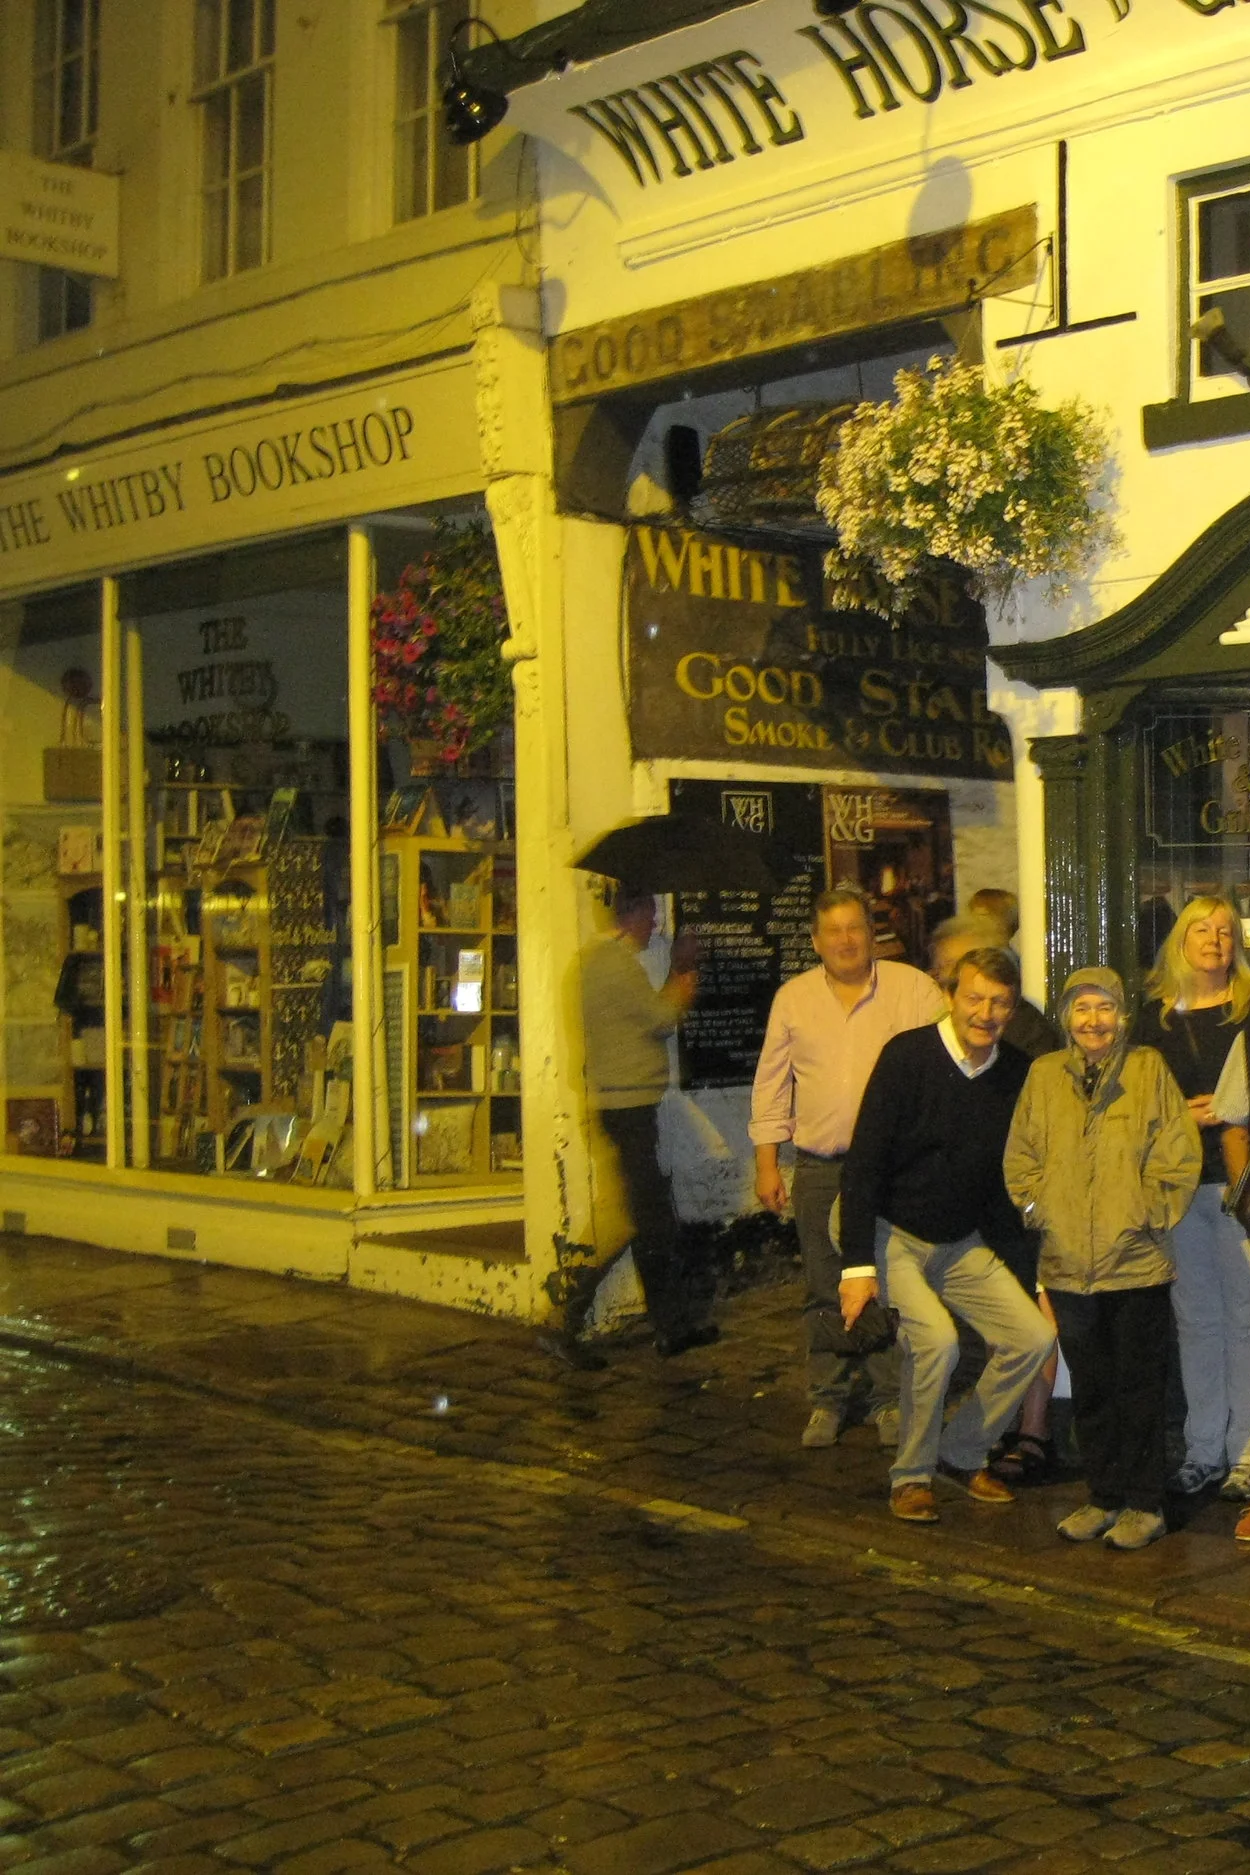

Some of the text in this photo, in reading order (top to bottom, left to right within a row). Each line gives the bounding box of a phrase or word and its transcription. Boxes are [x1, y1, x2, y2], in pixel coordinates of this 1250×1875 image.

[567, 0, 1086, 188] WHITE HORSE
[0, 407, 414, 553] THE WHITBY BOOKSHOP
[200, 616, 249, 654] THE
